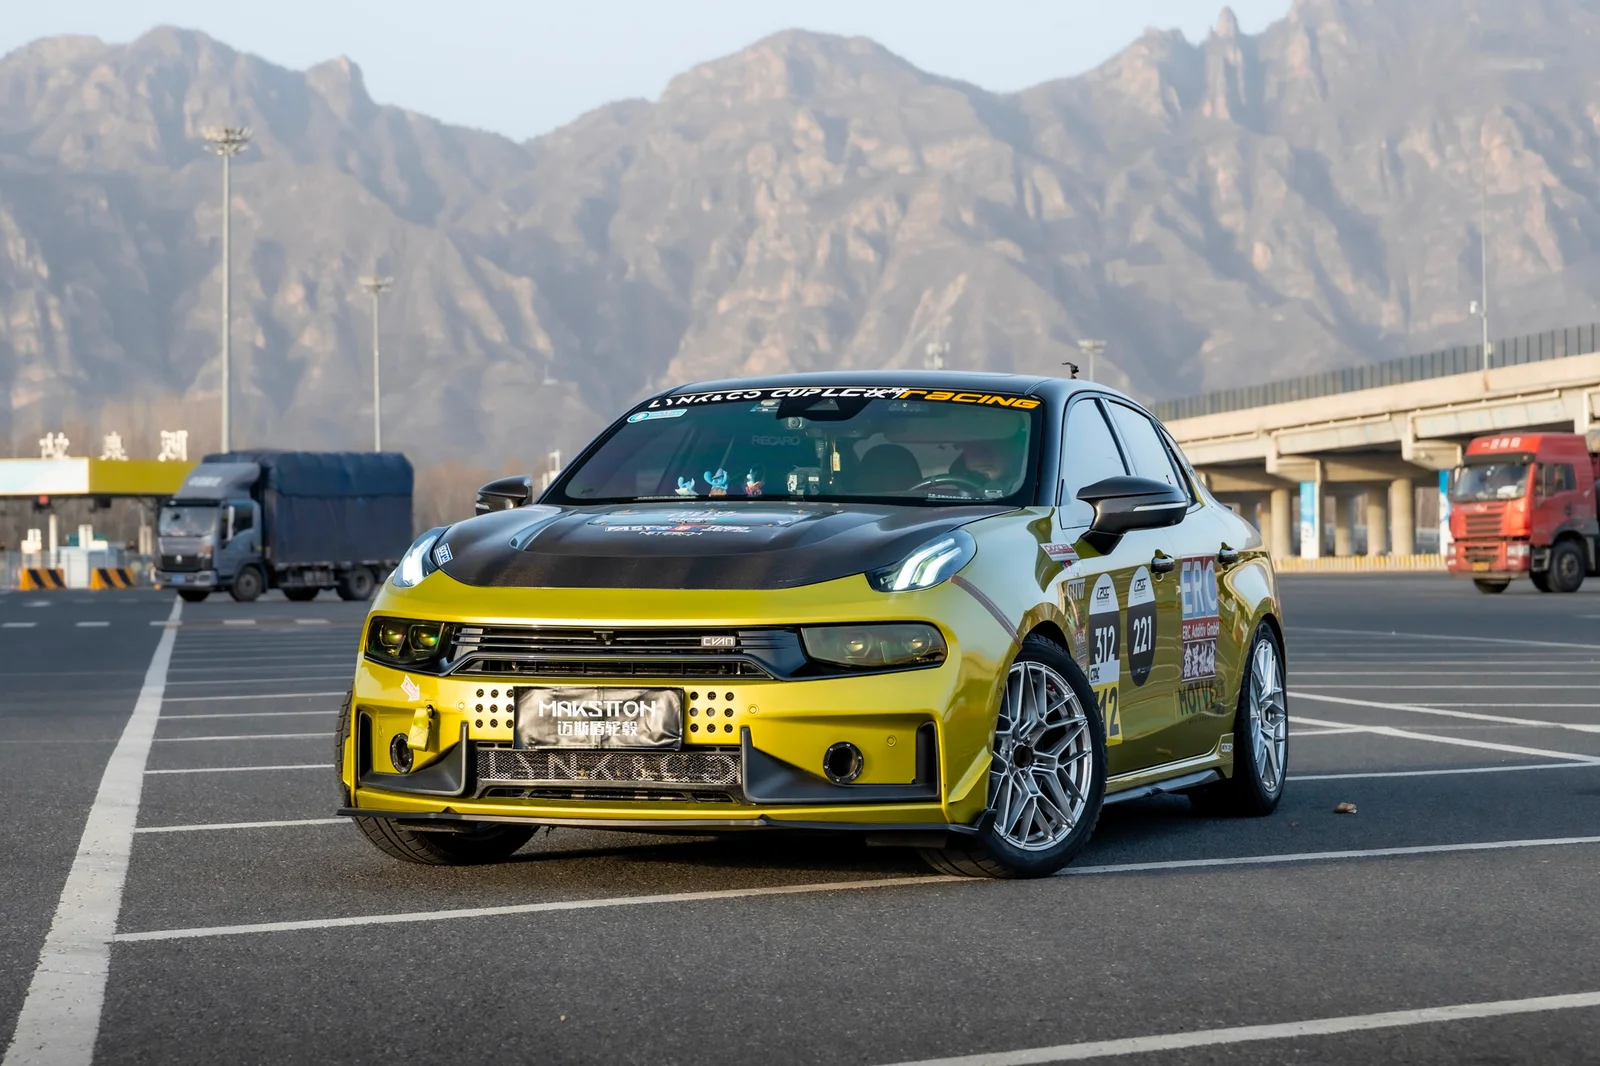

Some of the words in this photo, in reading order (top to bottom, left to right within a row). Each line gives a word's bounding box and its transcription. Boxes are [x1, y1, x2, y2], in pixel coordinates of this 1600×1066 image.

[751, 436, 800, 446] RECARO
[1180, 560, 1217, 614] ERC
[1094, 624, 1116, 665] 312
[1133, 615, 1152, 655] 221
[1093, 686, 1120, 737] 12
